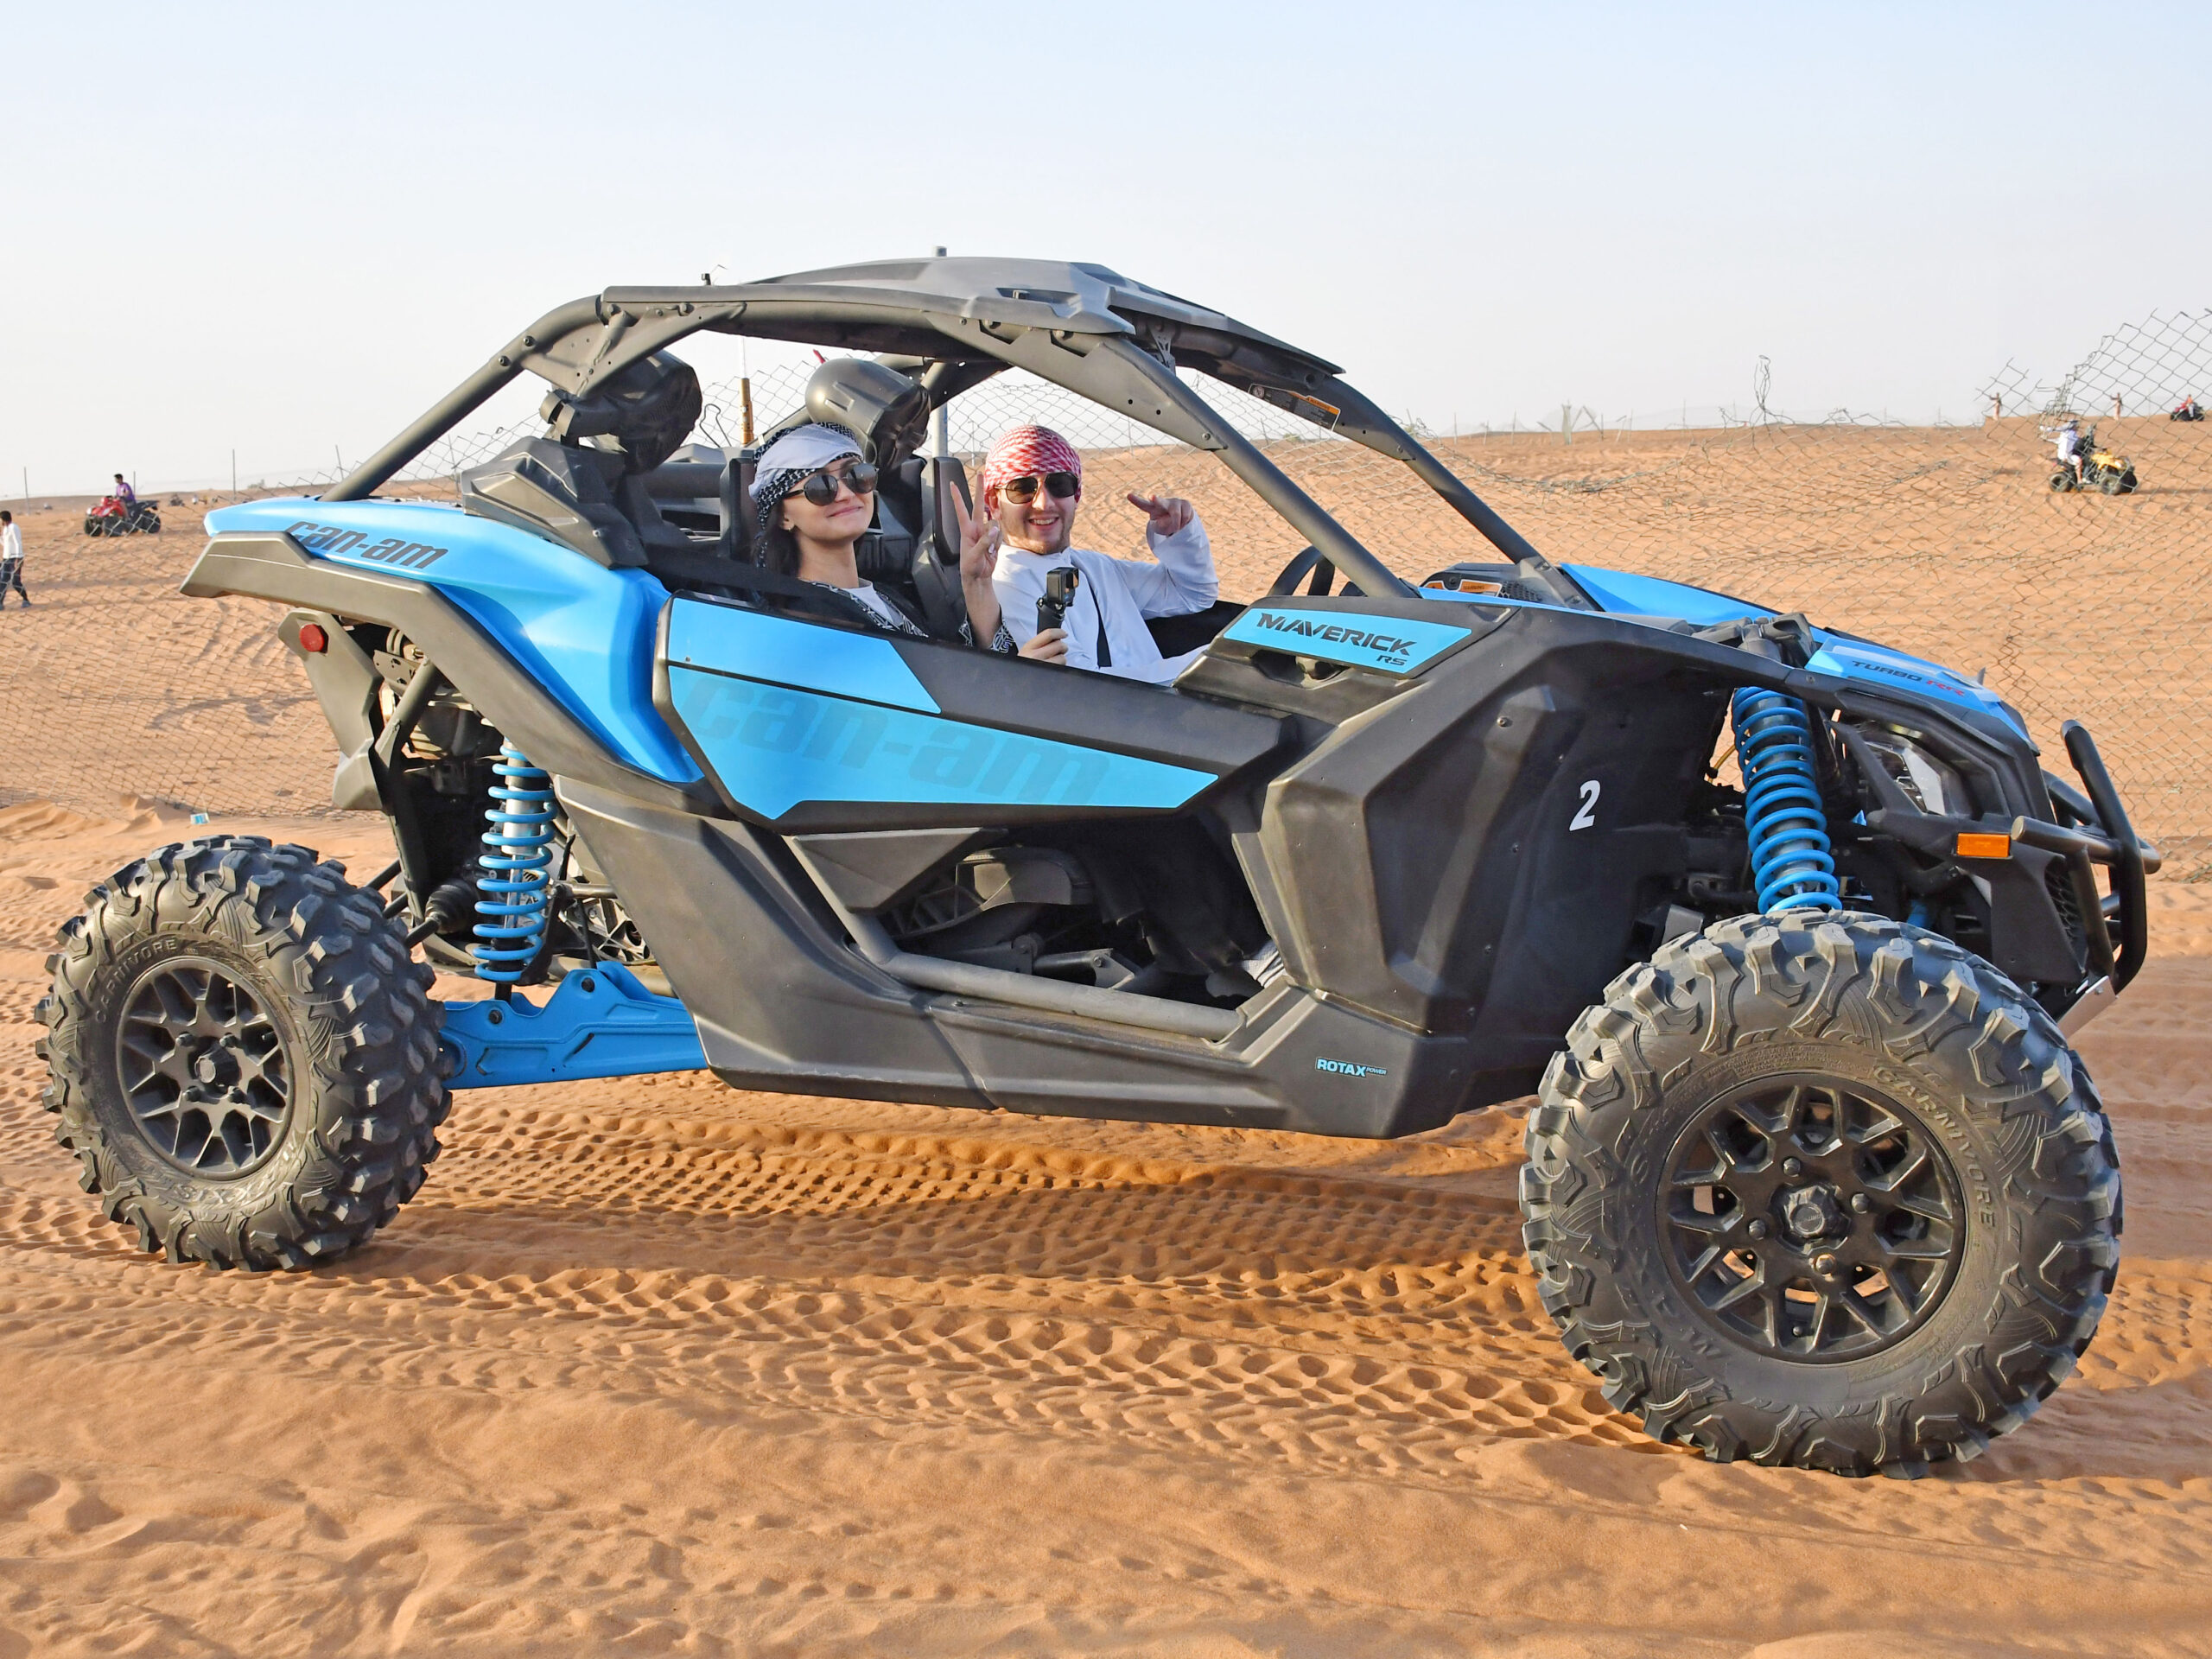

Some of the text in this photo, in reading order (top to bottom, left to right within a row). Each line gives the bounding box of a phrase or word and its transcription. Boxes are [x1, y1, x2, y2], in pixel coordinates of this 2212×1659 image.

[284, 521, 448, 569] can-am
[1256, 613, 1416, 656] MAVERICK
[1376, 655, 1407, 666] RS
[1852, 660, 1923, 682] TURBO
[690, 677, 1113, 802] can-am
[1568, 779, 1601, 832] 2
[1316, 1058, 1387, 1077] ROTAX POWER
[1872, 1065, 1995, 1227] CARNIVORE
